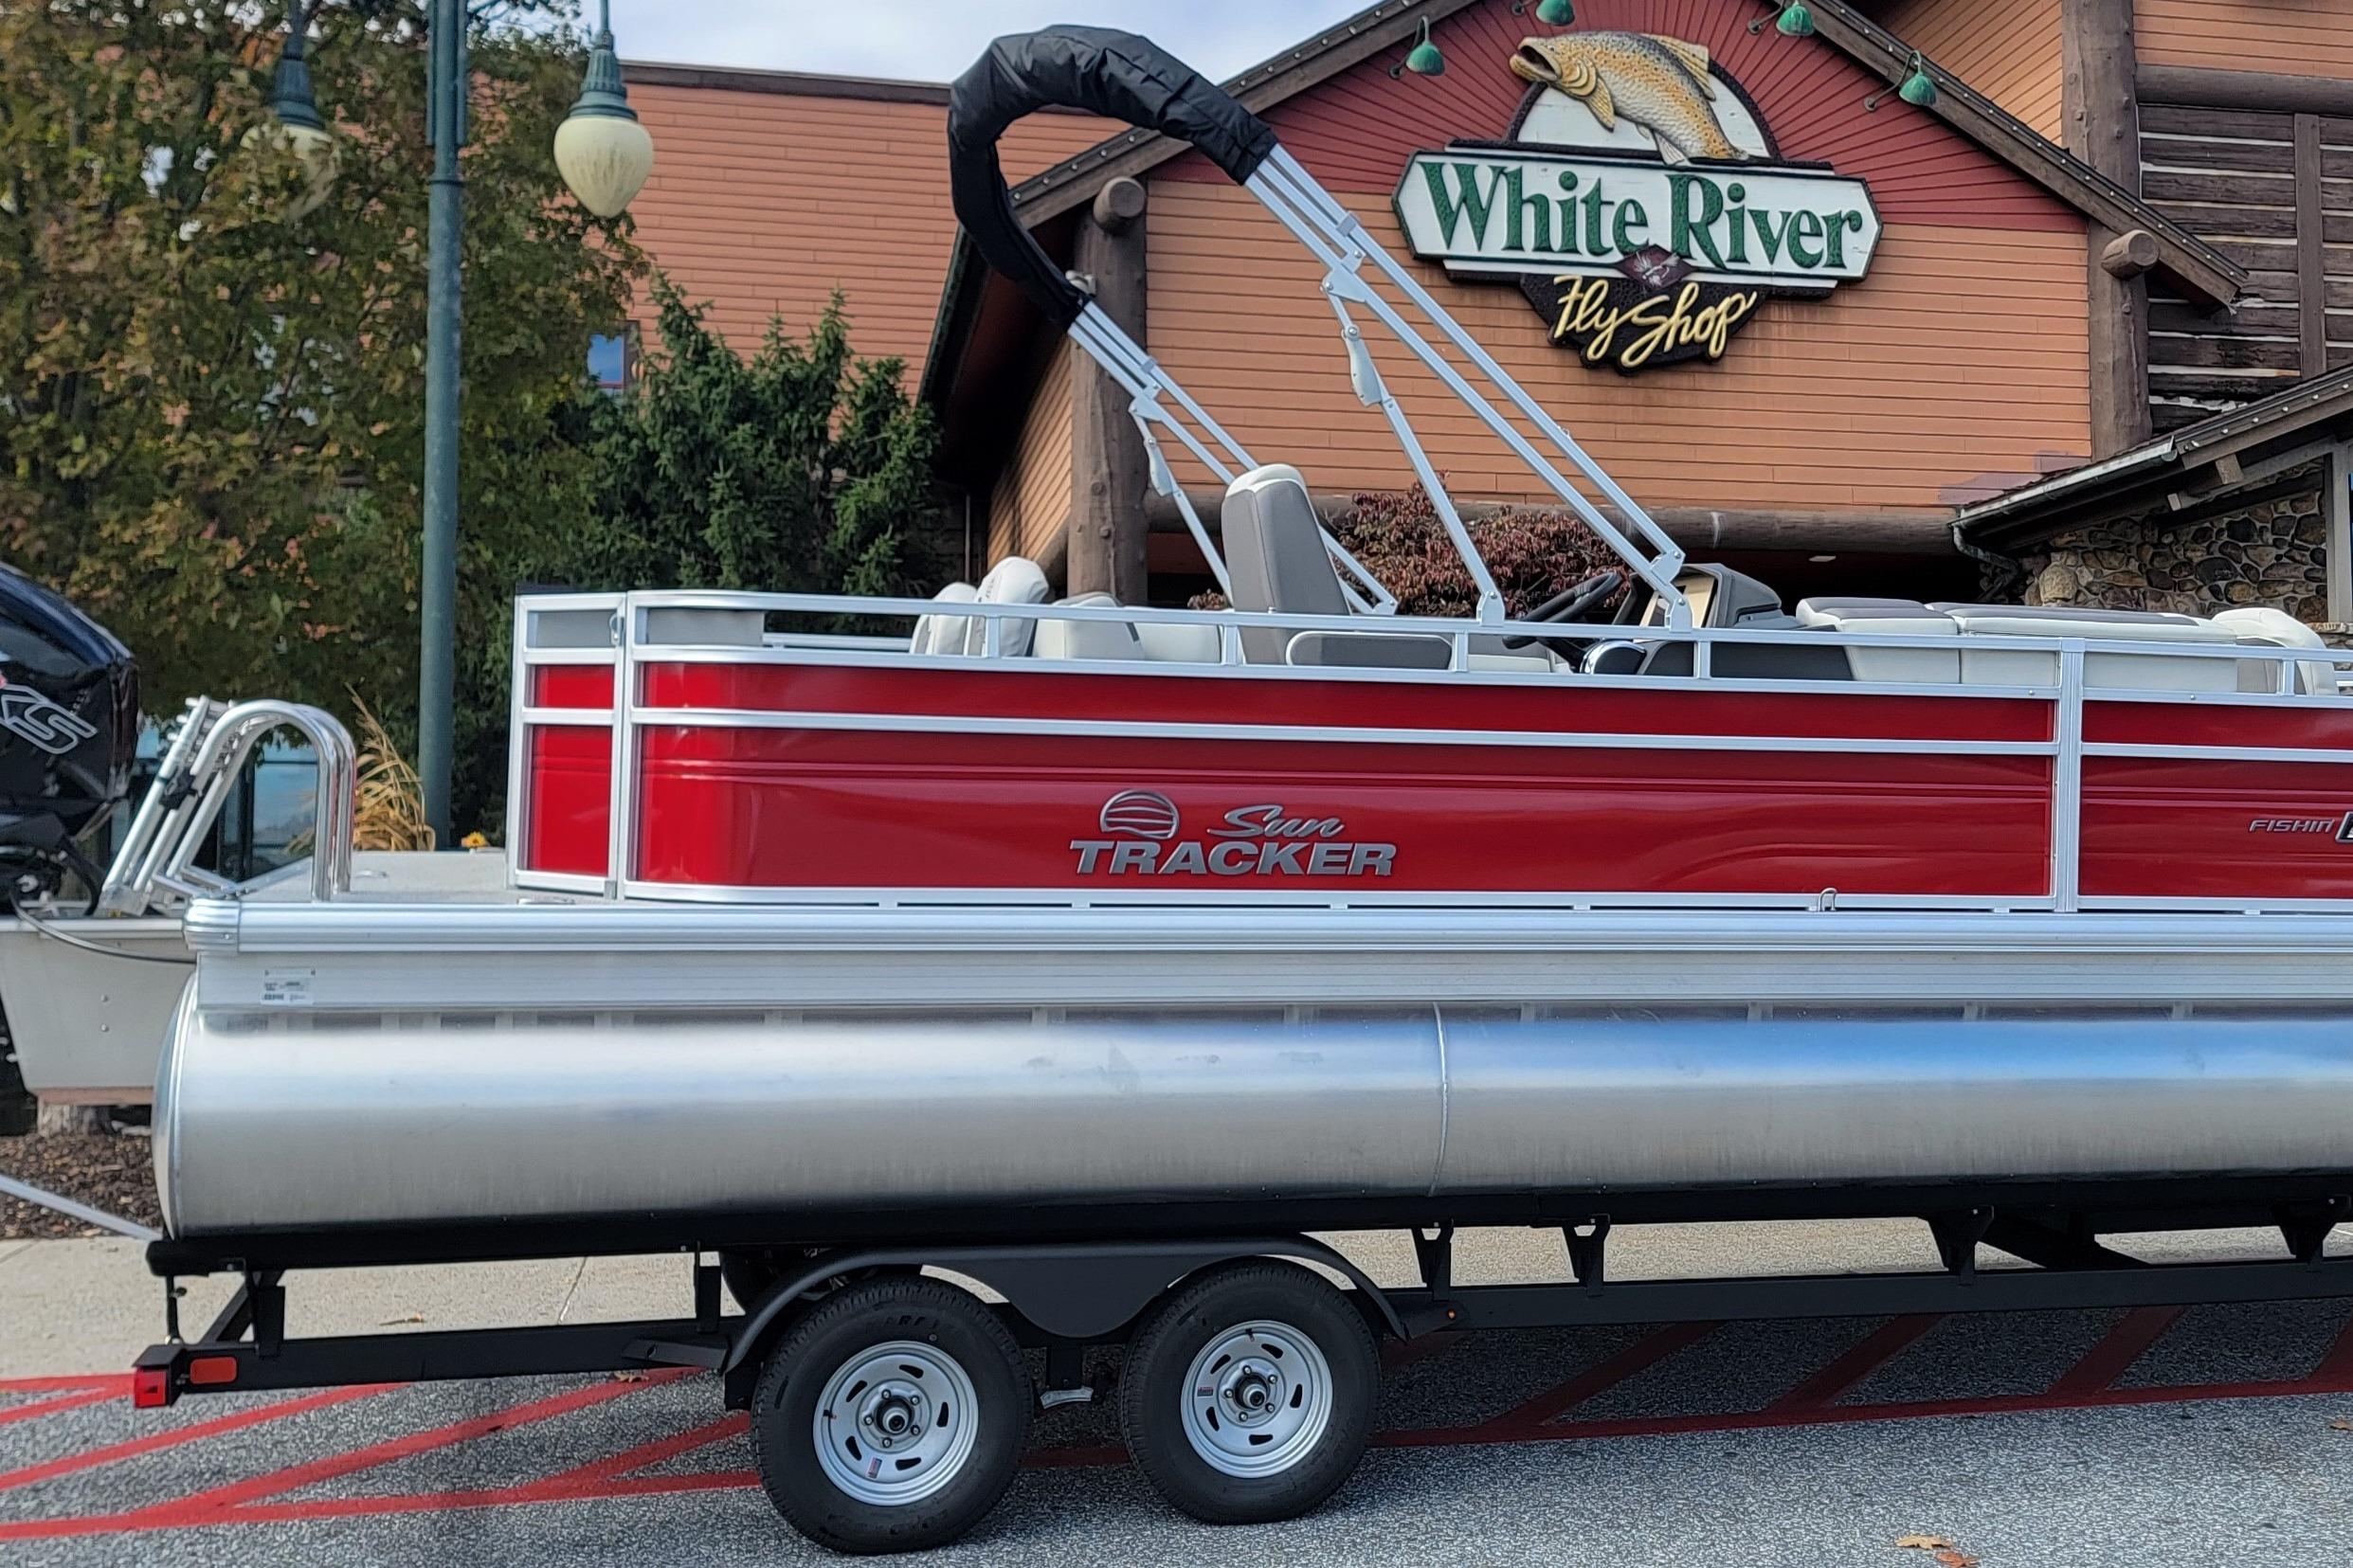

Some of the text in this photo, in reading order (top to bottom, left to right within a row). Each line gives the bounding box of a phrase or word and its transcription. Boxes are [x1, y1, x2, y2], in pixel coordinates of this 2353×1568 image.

[1416, 160, 1864, 271] White River
[1552, 275, 1758, 369] Fly Shop
[1206, 803, 1346, 839] Sun
[1069, 839, 1398, 877] TRACKER
